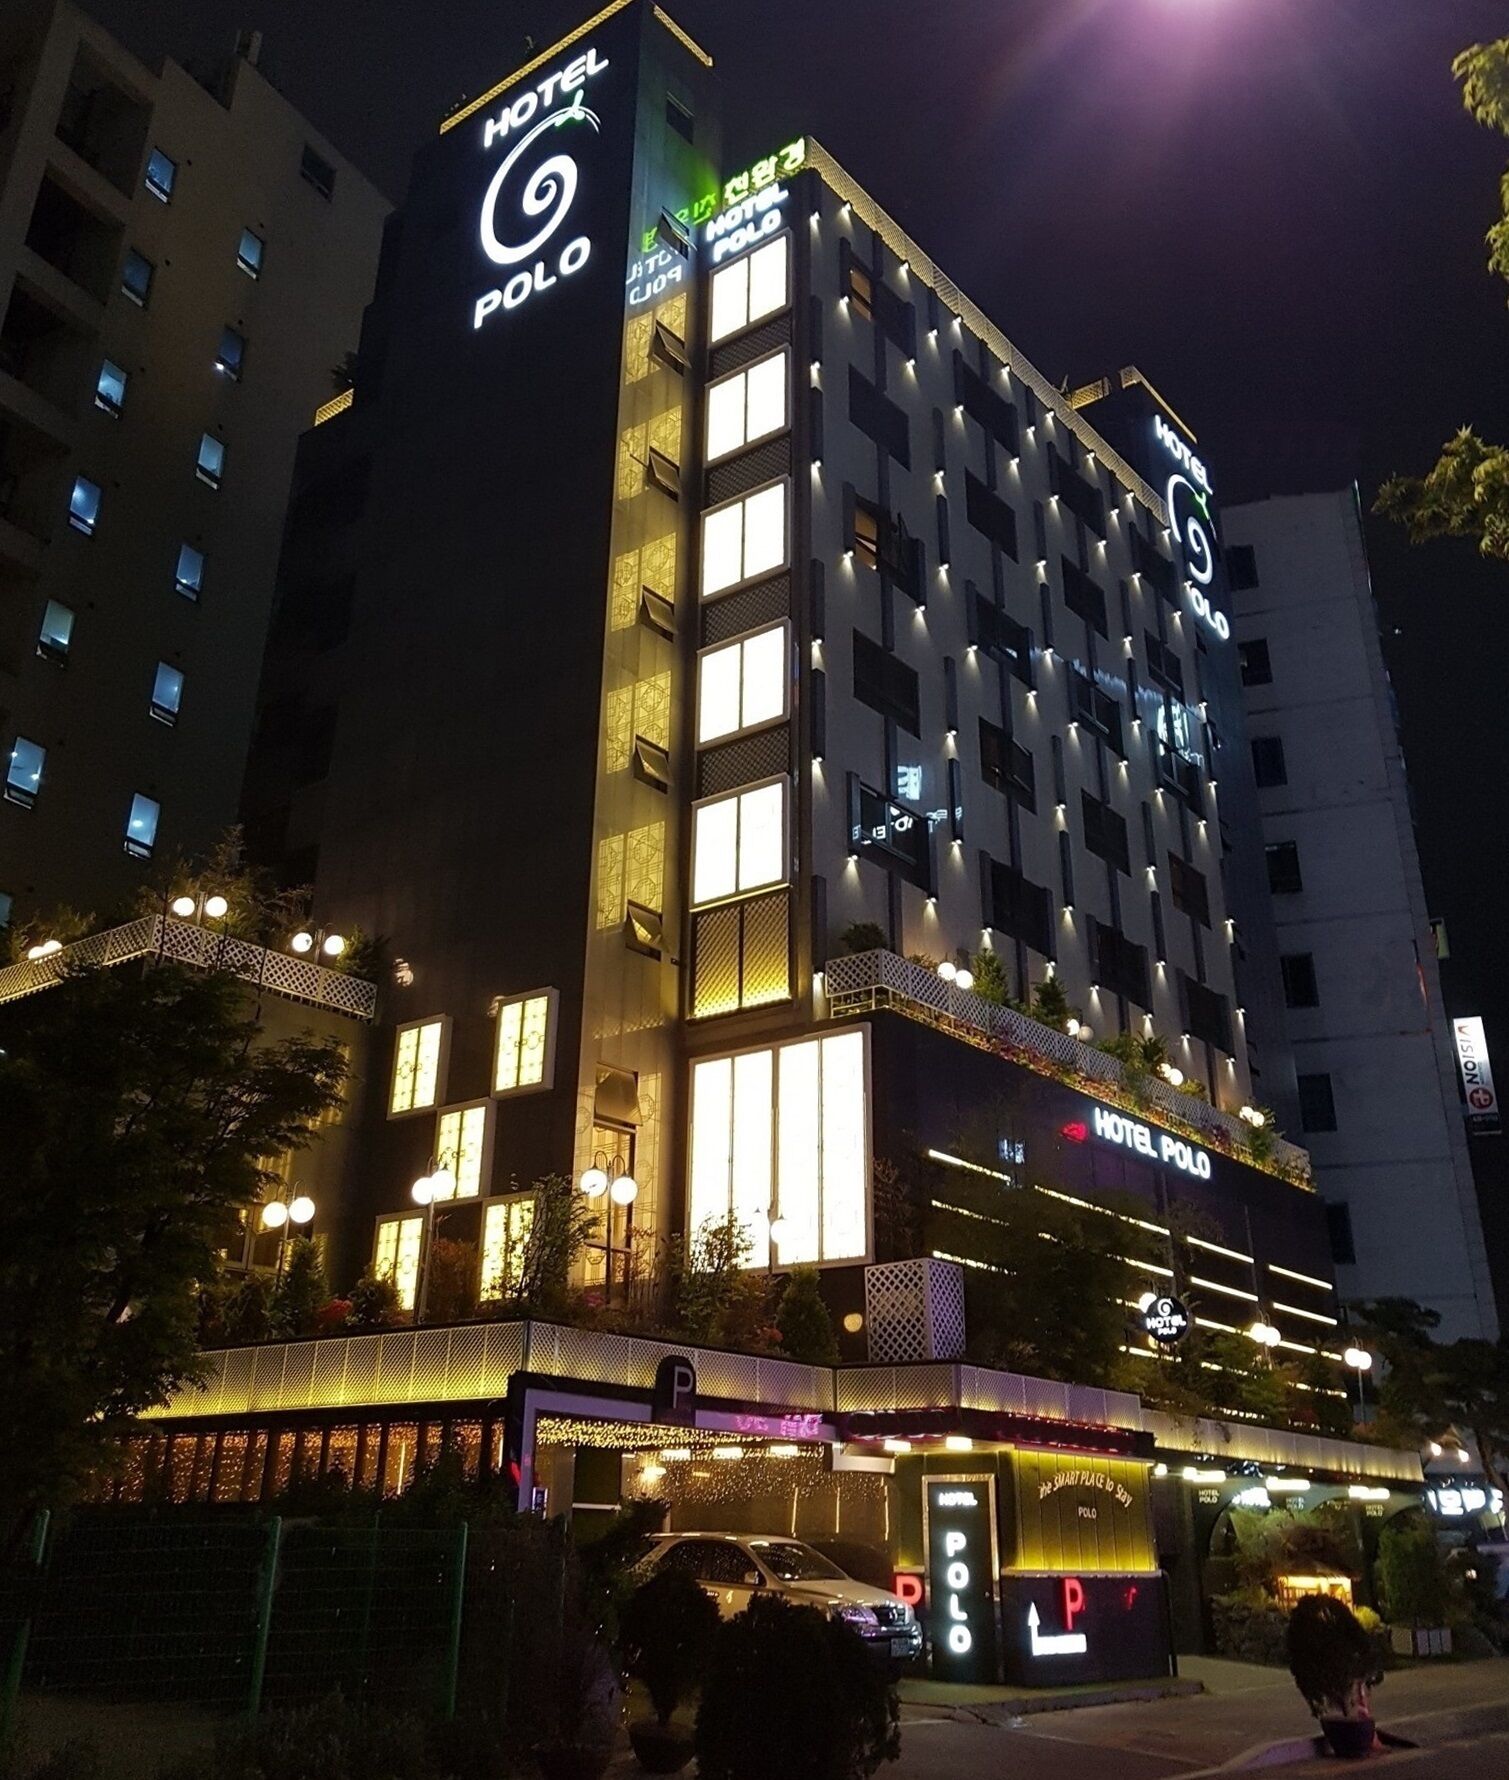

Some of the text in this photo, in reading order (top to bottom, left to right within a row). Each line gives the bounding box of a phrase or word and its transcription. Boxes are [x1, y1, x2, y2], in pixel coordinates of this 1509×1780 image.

[484, 48, 609, 148] HOTEL
[705, 183, 789, 241] HOTEL
[713, 208, 781, 263] POLO
[473, 236, 591, 329] POLO
[1154, 414, 1213, 495] HOTEL
[1457, 1024, 1480, 1085] VISION
[1094, 1107, 1211, 1180] HOTEL POLO
[1146, 1314, 1187, 1329] HOTEL
[673, 1366, 694, 1409] P
[1053, 1471, 1080, 1491] SMART
[1081, 1470, 1105, 1489] PLACE
[1105, 1477, 1114, 1492] to
[1115, 1483, 1133, 1508] Stay
[1078, 1506, 1097, 1519] POLO
[1199, 1495, 1218, 1504] POLO
[946, 1532, 972, 1653] POLO
[1065, 1578, 1083, 1631] P
